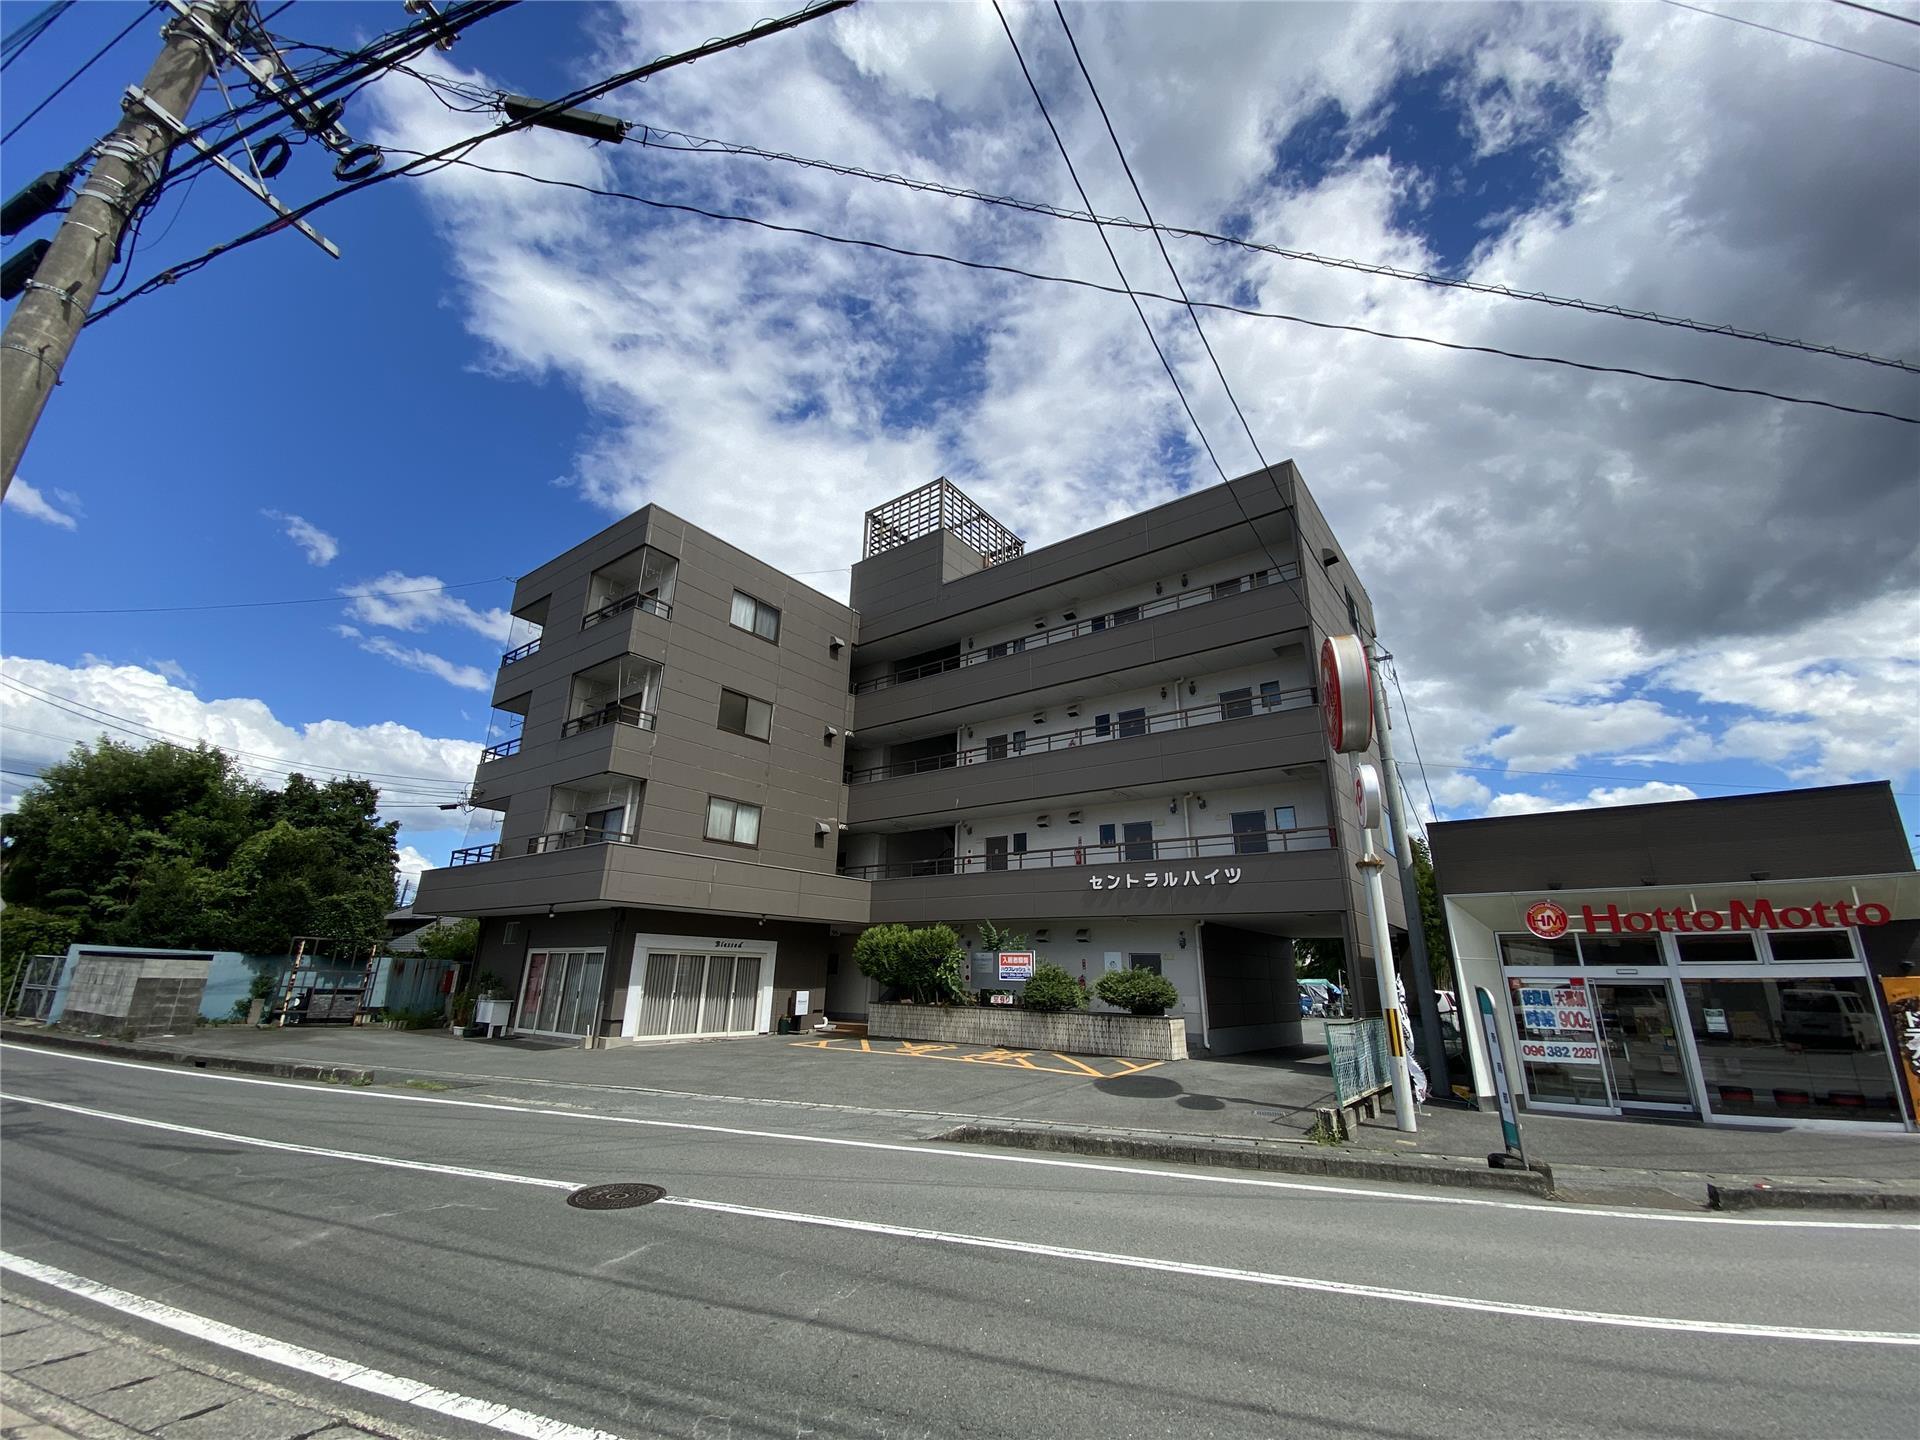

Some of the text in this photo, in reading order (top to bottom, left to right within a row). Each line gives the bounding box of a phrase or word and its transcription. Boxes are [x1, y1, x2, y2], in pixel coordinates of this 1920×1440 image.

[1089, 867, 1242, 890] セントラルハイツ
[1531, 914, 1562, 927] HM
[1523, 1045, 1598, 1059] 096 382 2287
